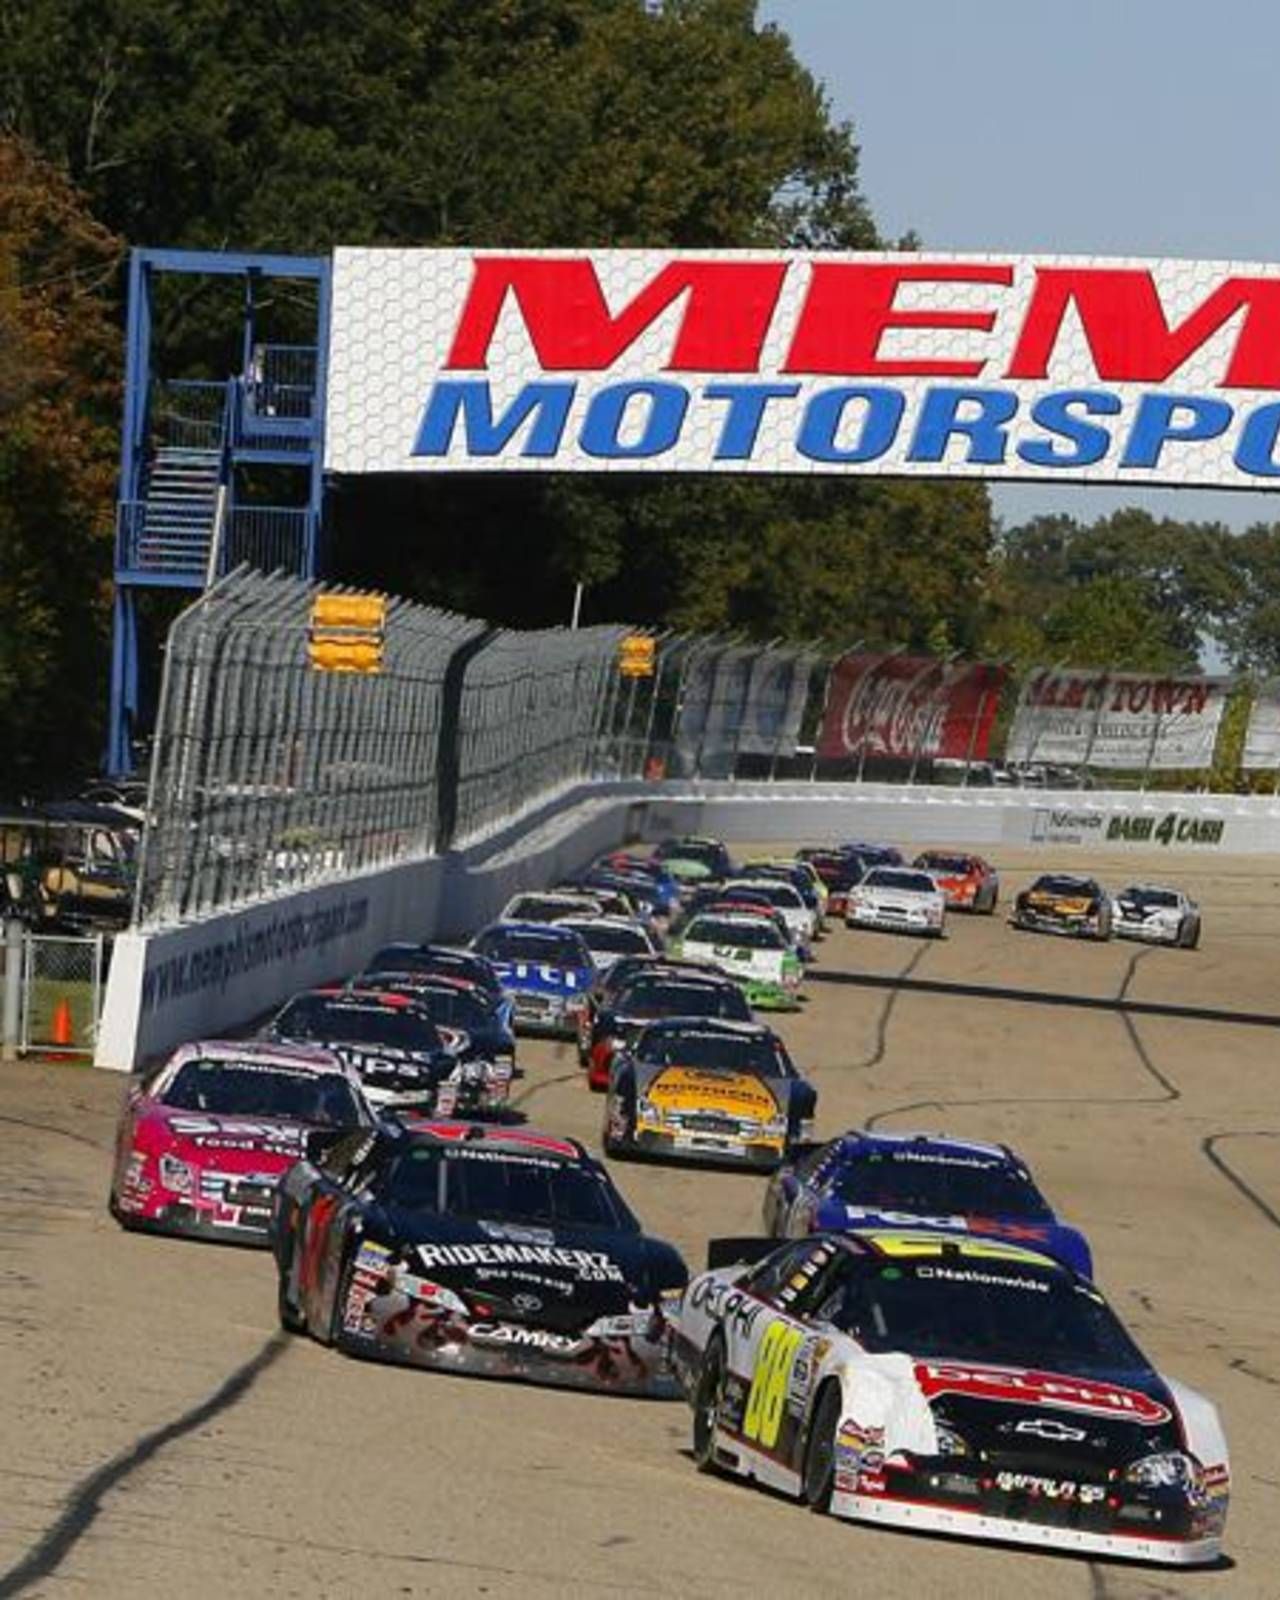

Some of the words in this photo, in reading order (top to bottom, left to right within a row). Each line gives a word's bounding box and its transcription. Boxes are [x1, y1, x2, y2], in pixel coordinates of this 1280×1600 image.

[1106, 815, 1155, 841] DASH
[1154, 812, 1177, 846] 4
[1176, 819, 1225, 845] CASH
[846, 1206, 1048, 1242] FedEx
[416, 1243, 618, 1272] RIDEMAKERZ
[935, 1266, 1049, 1293] Nationwide
[467, 1323, 582, 1350] CAMRY
[743, 1320, 804, 1448] 88
